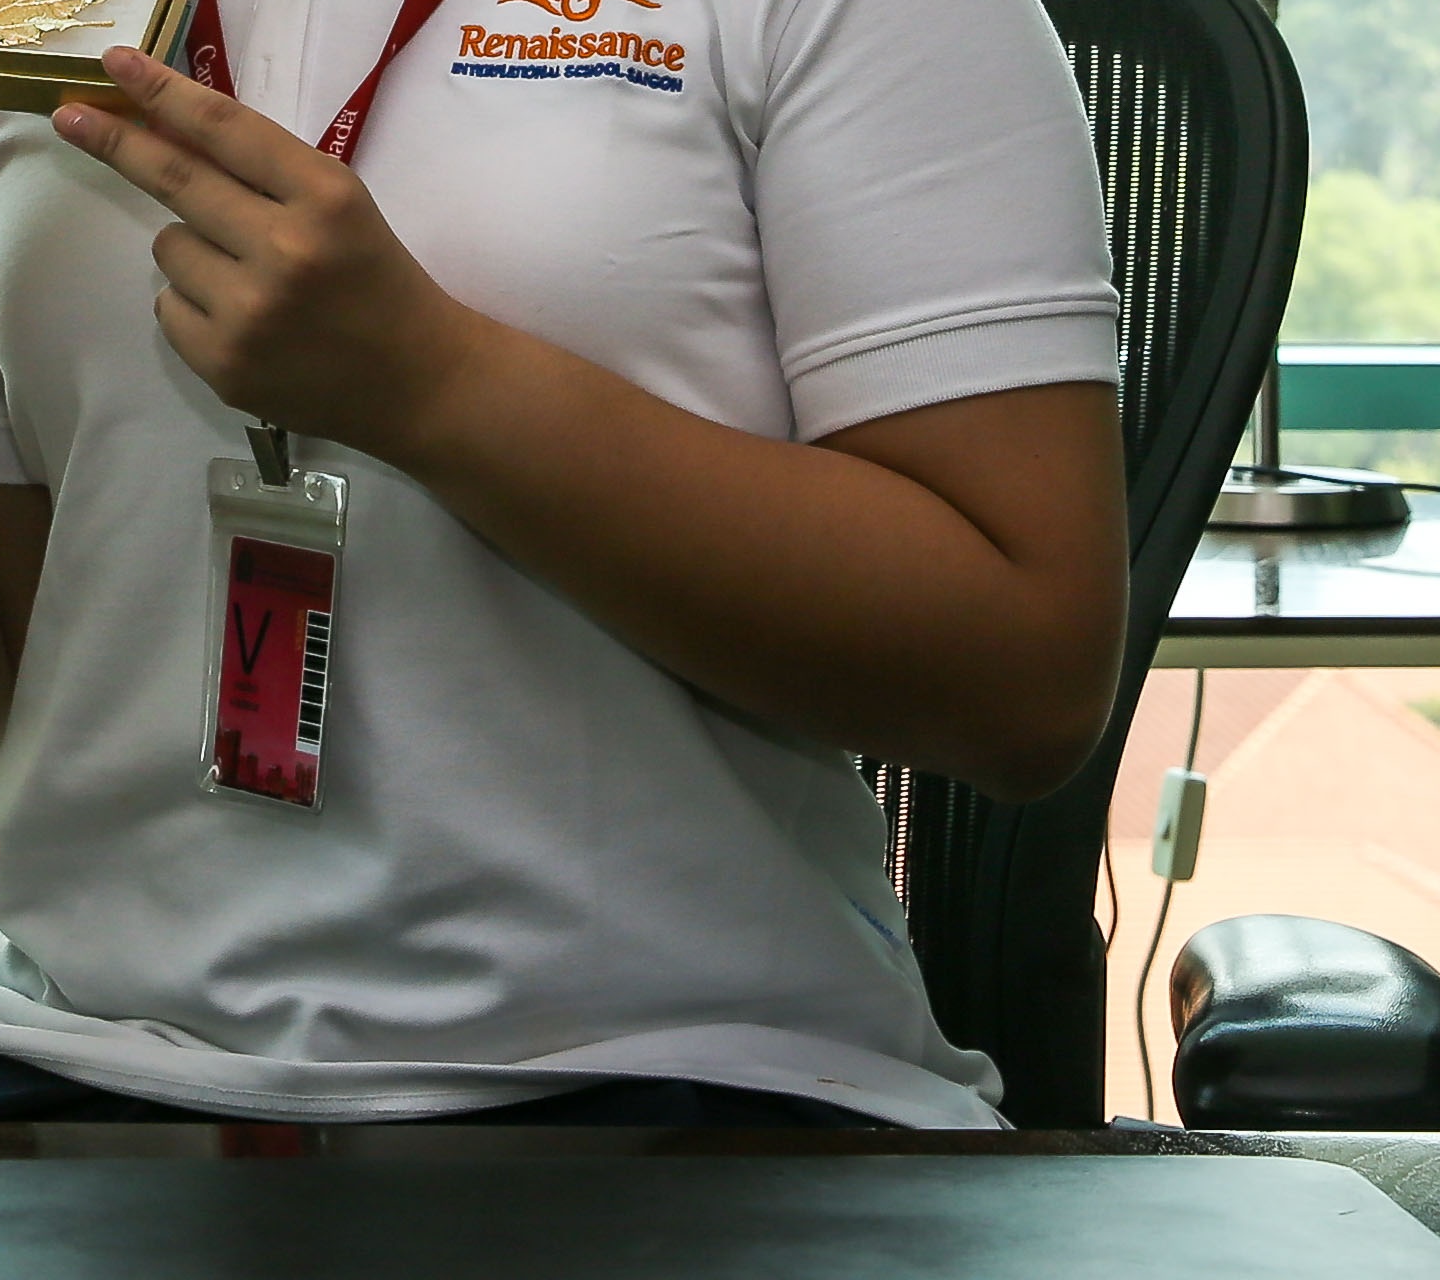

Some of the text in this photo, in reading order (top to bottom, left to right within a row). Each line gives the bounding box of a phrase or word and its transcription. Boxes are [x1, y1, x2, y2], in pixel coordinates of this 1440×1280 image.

[193, 44, 217, 89] Can
[458, 24, 685, 71] Renaissance
[233, 601, 273, 676] V
